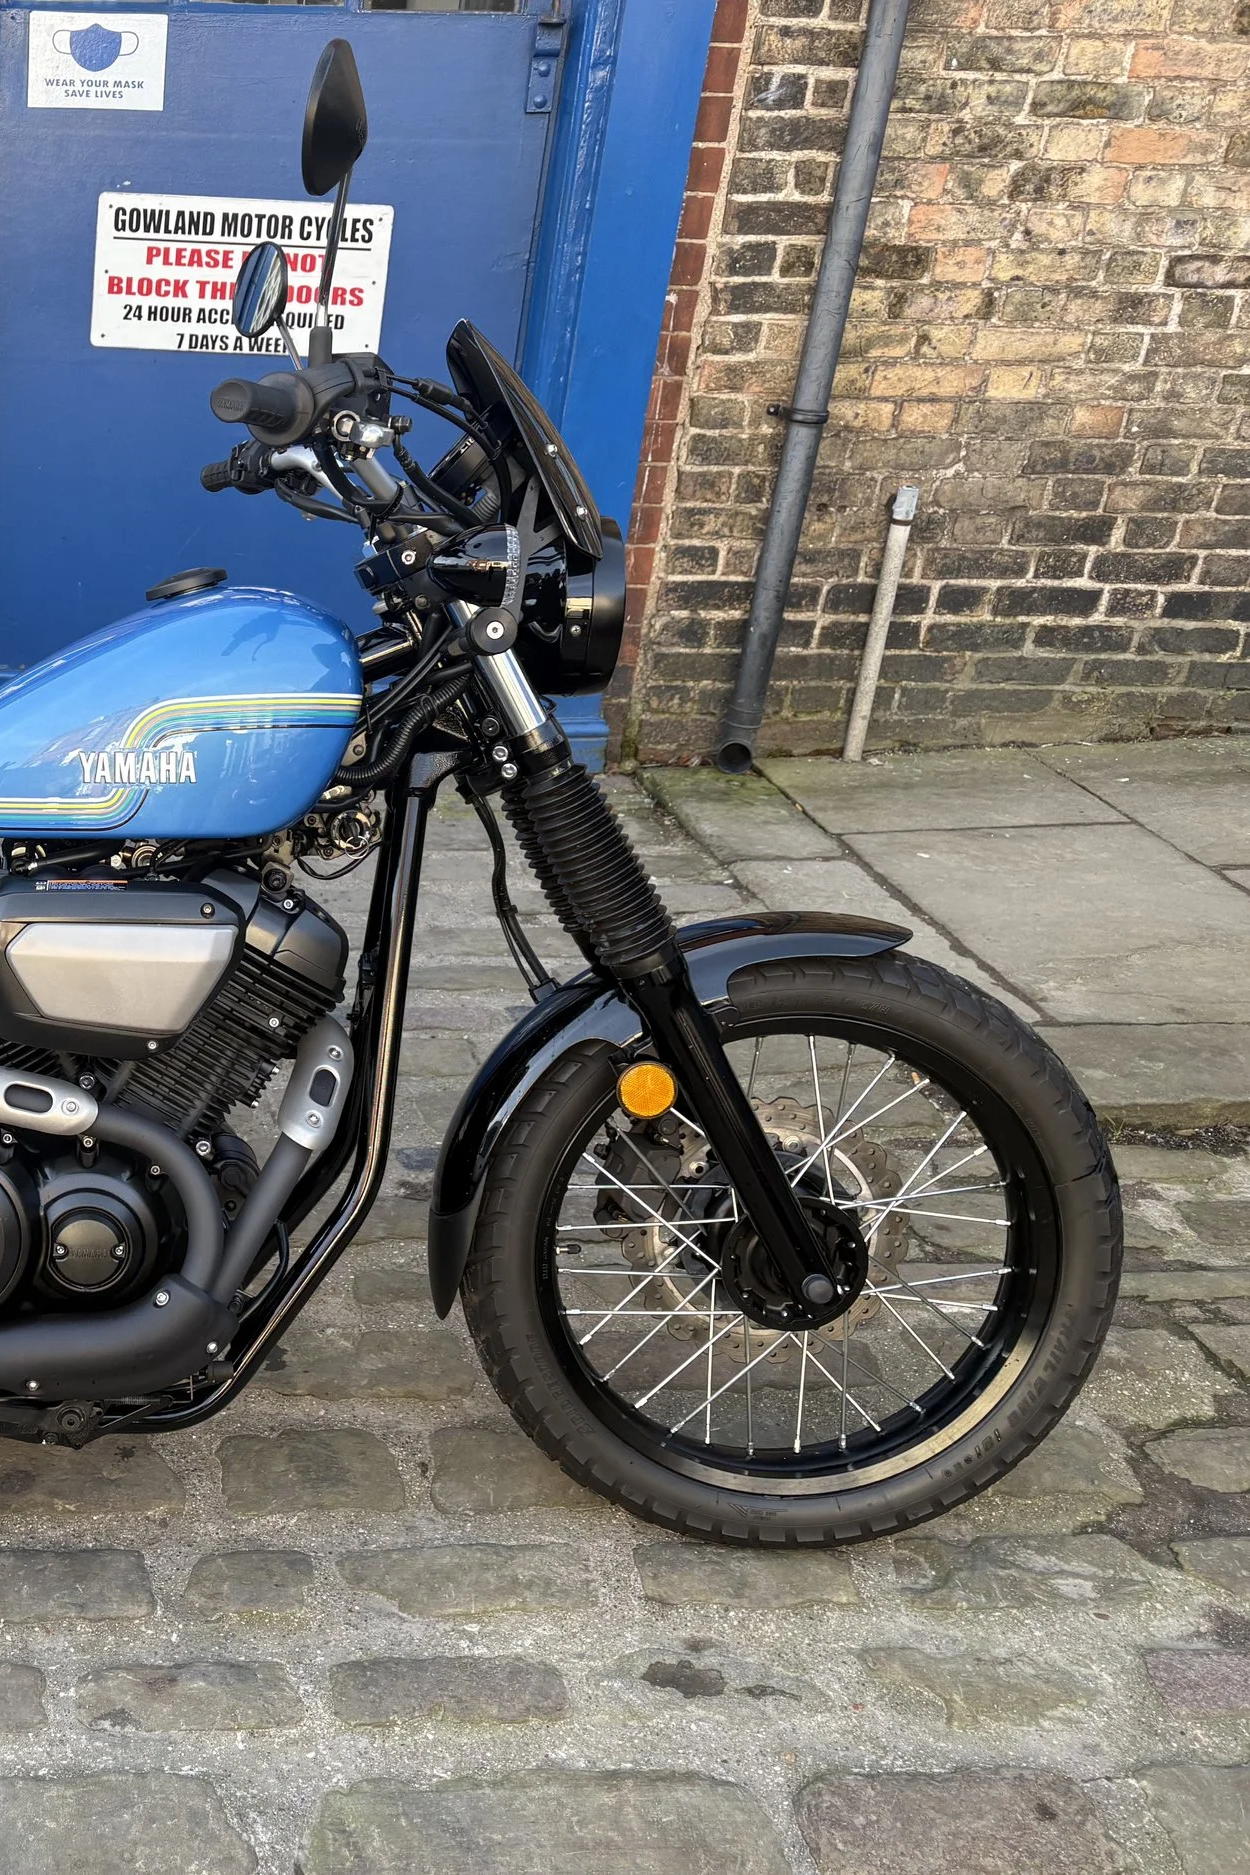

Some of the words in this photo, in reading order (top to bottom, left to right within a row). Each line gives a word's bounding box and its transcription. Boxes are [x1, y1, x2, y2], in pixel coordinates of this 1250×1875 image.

[44, 78, 76, 87] WEAR
[79, 79, 109, 88] YOUR
[112, 80, 145, 89] MASK
[64, 89, 91, 98] SAVE
[95, 90, 124, 99] LIVES
[114, 206, 216, 237] GOWLAND
[221, 212, 293, 240] MOTOR
[146, 246, 235, 269] PLEASE
[107, 276, 190, 298] BLOCK
[122, 304, 143, 321] 24
[147, 305, 192, 323] HOUR
[176, 333, 185, 349] 7
[189, 334, 230, 352] DAYS
[234, 336, 244, 353] A
[249, 337, 287, 354] WEE
[78, 750, 197, 784] YAMAHA
